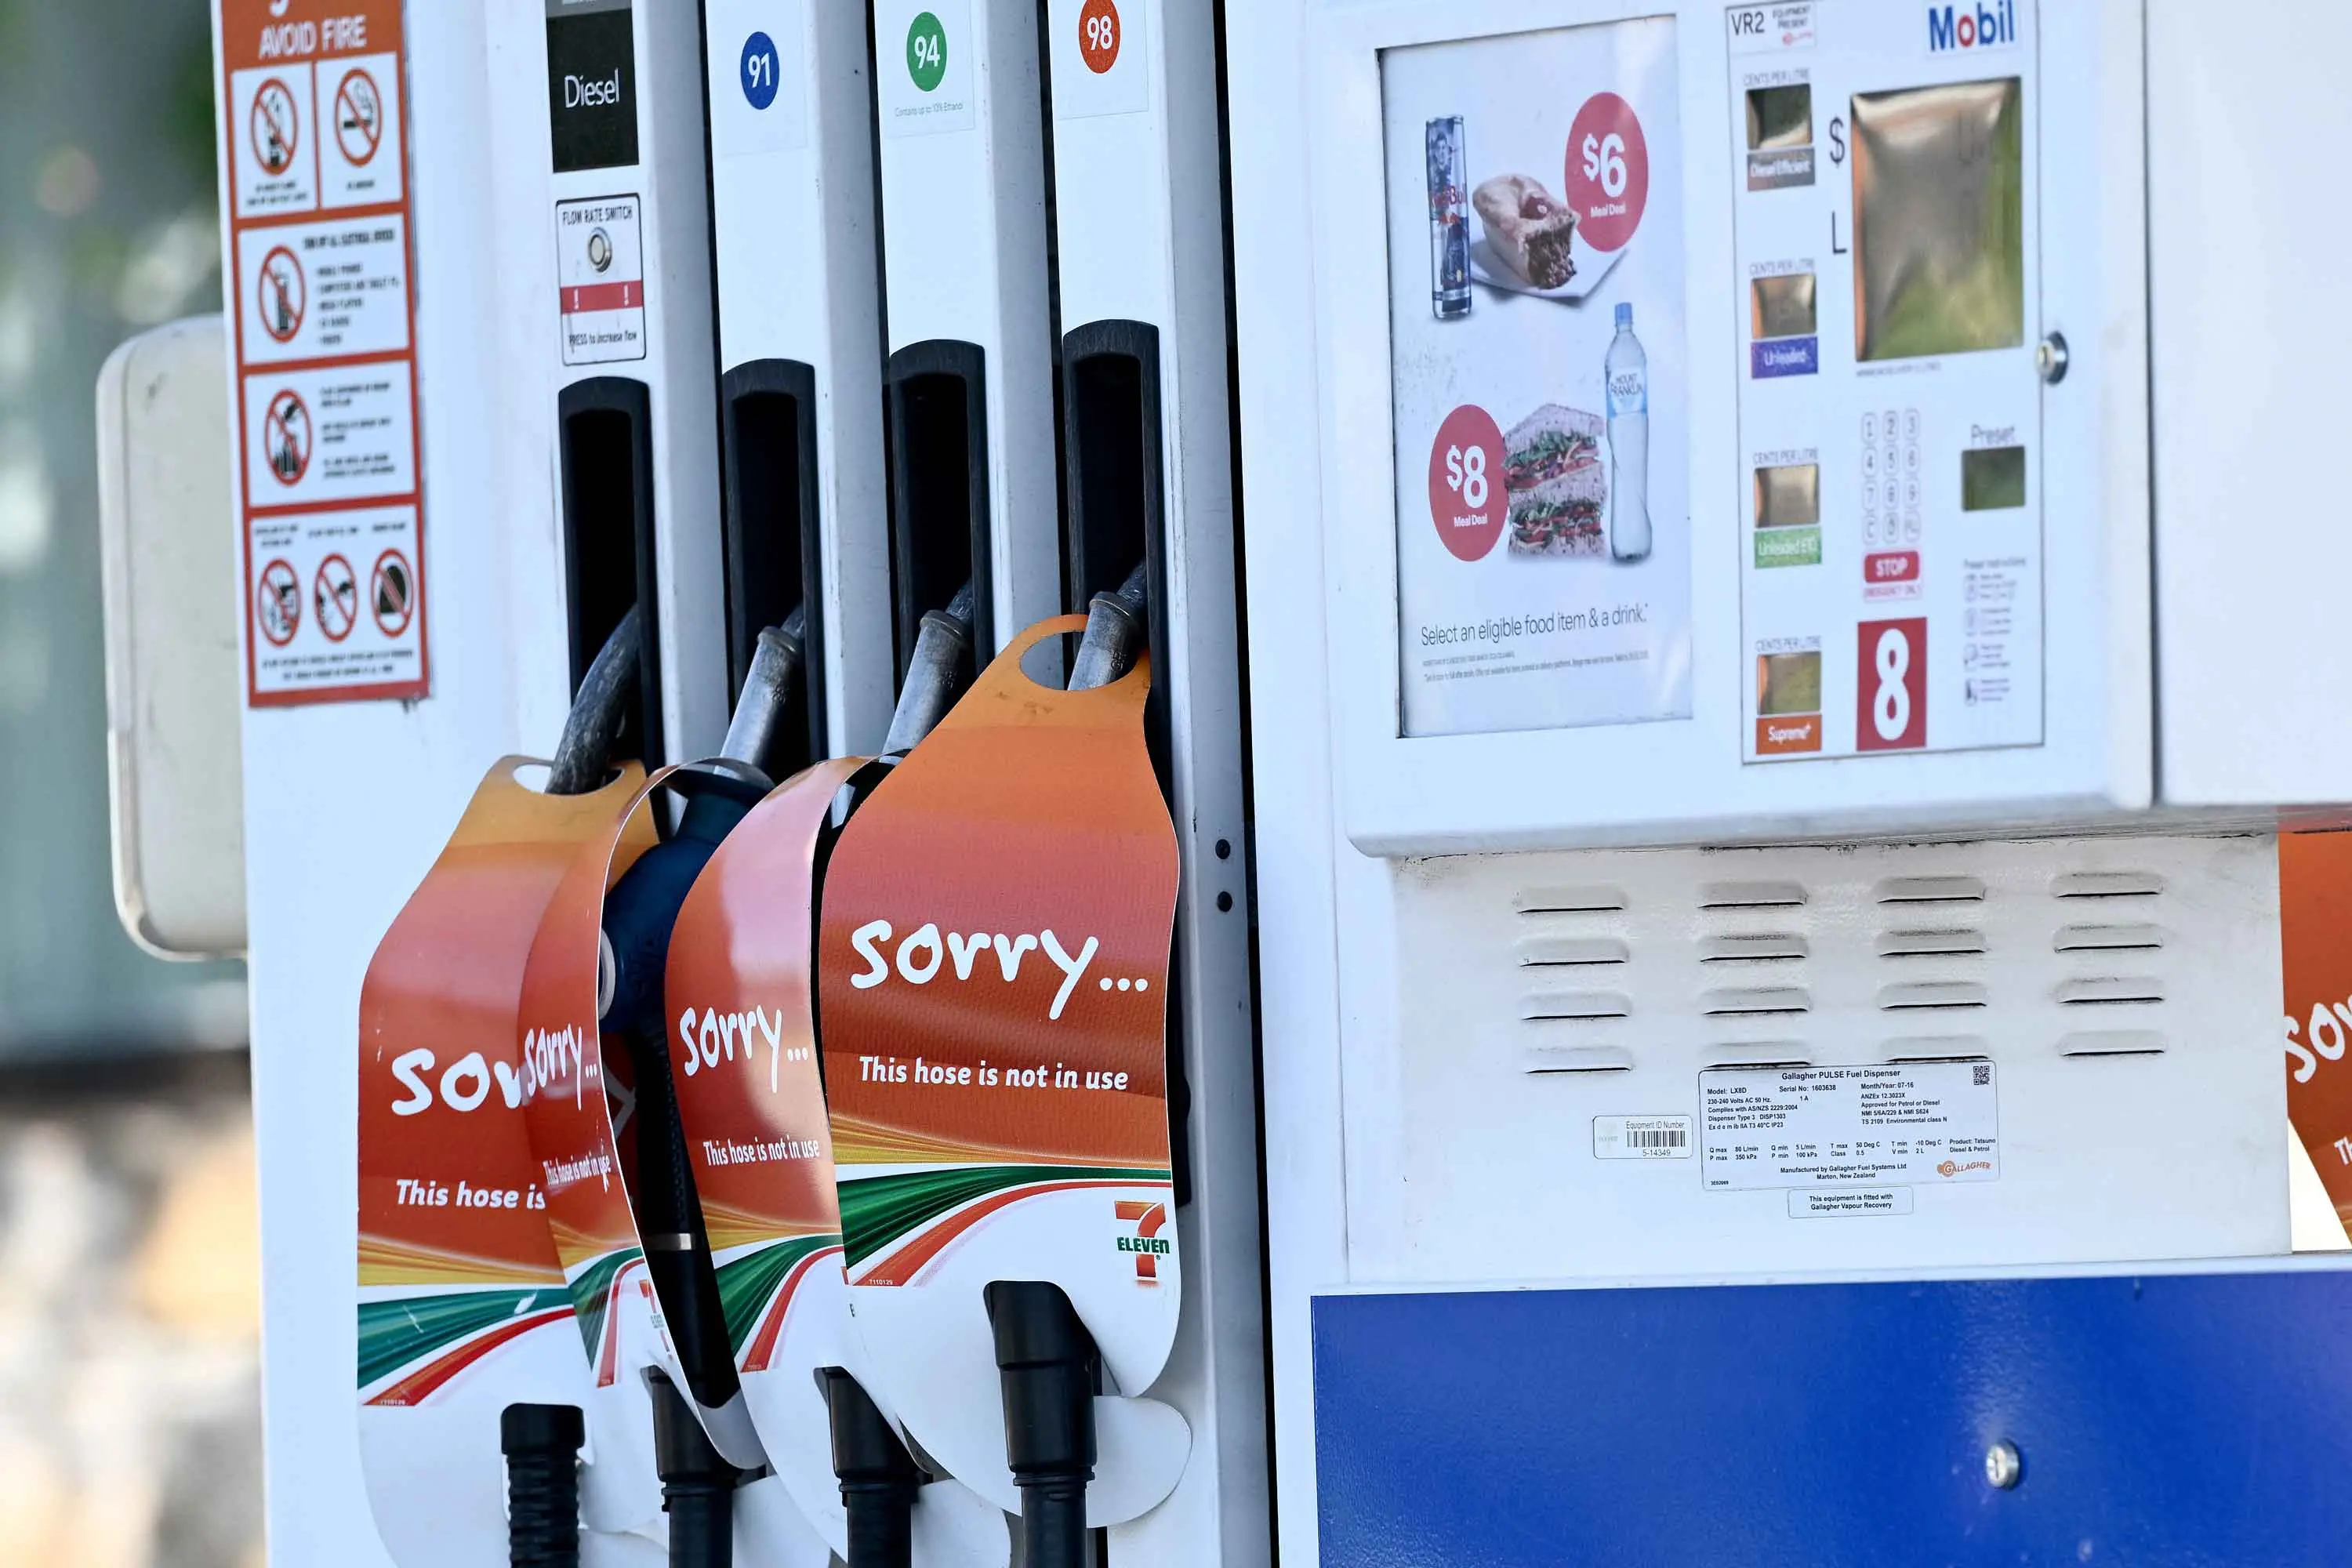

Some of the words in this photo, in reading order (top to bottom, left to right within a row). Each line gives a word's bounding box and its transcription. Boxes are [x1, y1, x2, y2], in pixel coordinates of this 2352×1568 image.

[258, 20, 317, 60] AVOID
[321, 14, 367, 51] FIRE
[1087, 15, 1113, 51] 98
[1731, 11, 1765, 35] VR2
[1929, 0, 2013, 51] Mobil
[914, 34, 940, 69] 94
[564, 68, 619, 108] Diesel
[748, 53, 771, 89] 91
[1829, 116, 1845, 168] $
[1583, 132, 1627, 198] $6
[563, 209, 582, 225] FLOW
[584, 208, 602, 223] RATE
[605, 205, 633, 221] SWITCH
[1590, 205, 1608, 218] Meal
[1609, 202, 1627, 216] Deal
[1832, 211, 1847, 255] L
[569, 332, 587, 345] PRESS
[1972, 423, 2014, 446] Preset
[1446, 445, 1488, 508] $8
[1454, 515, 1471, 527] Meal
[1472, 513, 1487, 524] Deal
[1875, 558, 1908, 577] STOP
[1421, 624, 1457, 645] Select
[1461, 626, 1475, 641] an
[1479, 616, 1522, 644] eligible
[1525, 614, 1555, 634] food
[1558, 612, 1585, 632] item
[1588, 608, 1599, 627] &
[1602, 612, 1610, 626] a
[1874, 628, 1911, 741] 8
[858, 1056, 907, 1083] This
[914, 1057, 971, 1085] hose
[978, 1060, 998, 1087] is
[1006, 1065, 1047, 1088] not
[1055, 1062, 1078, 1090] in
[1085, 1070, 1129, 1091] use
[1781, 1072, 1817, 1081] Gallagher
[1864, 1070, 1900, 1079] Dispenser
[1626, 1121, 1654, 1130] Equipment
[702, 1141, 729, 1167] This
[728, 1138, 756, 1164] hose
[755, 1136, 767, 1162] is
[768, 1137, 788, 1161] not
[786, 1134, 800, 1160] in
[801, 1139, 820, 1159] use
[1944, 1162, 1991, 1174] GALLAGHER
[396, 1178, 448, 1206] This
[456, 1180, 519, 1209] hose
[526, 1184, 546, 1210] is
[1824, 1195, 1856, 1203] equipment
[1114, 1200, 1167, 1278] 7
